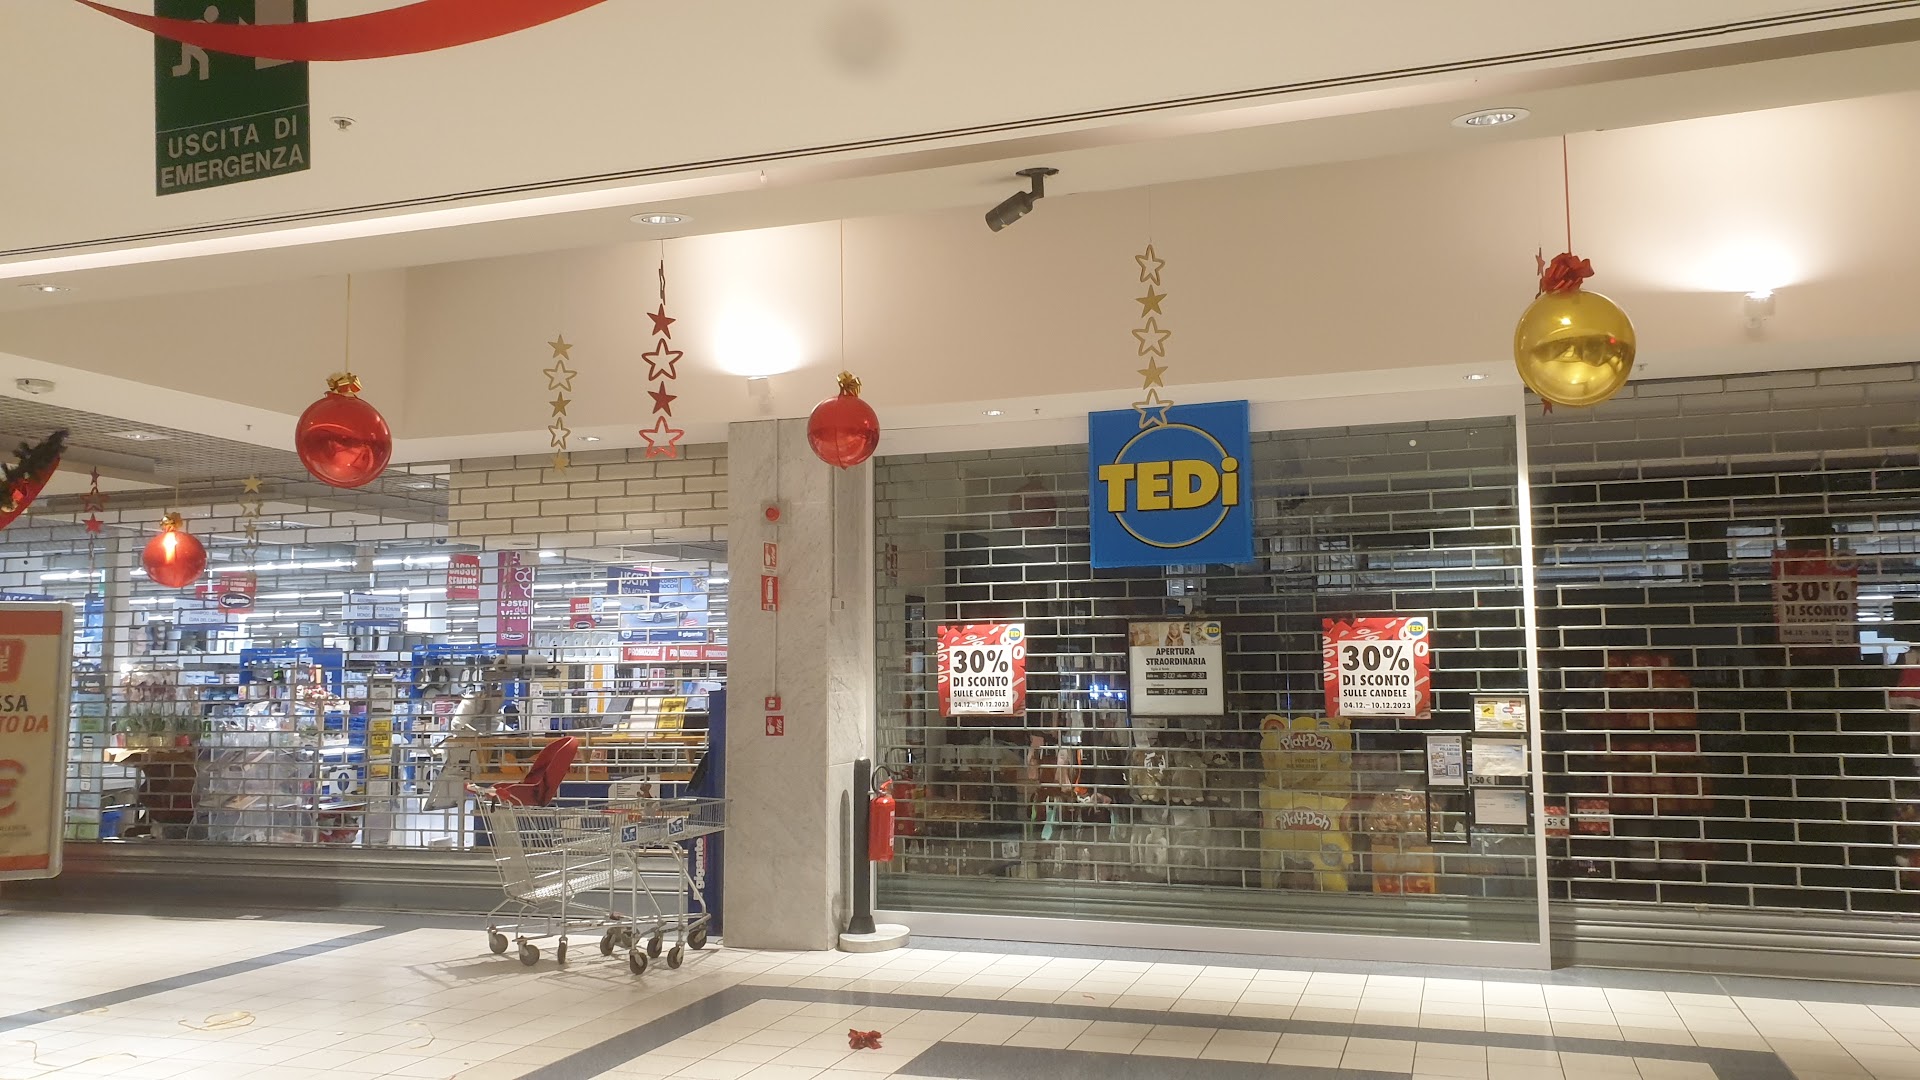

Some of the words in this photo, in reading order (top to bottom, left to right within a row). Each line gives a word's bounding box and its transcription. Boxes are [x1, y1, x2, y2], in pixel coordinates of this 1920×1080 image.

[168, 123, 260, 159] USCITA
[274, 114, 297, 140] DI
[160, 143, 304, 189] EMERGENZA
[1098, 457, 1239, 512] TEDi
[1799, 605, 1848, 616] SCONTO
[1156, 647, 1195, 656] APERTURA
[1342, 645, 1410, 671] 30%
[953, 649, 1009, 673] 30%
[1146, 657, 1206, 666] STRAORDINARIA
[953, 676, 964, 687] DI
[968, 676, 1009, 687] SCONTO
[1343, 675, 1355, 686] DI
[1360, 674, 1410, 686] SCONTO
[953, 690, 973, 698] SULLE
[1343, 689, 1367, 697] SULLE
[1370, 689, 1407, 697] CANDELE
[0, 695, 28, 711] SA
[23, 715, 48, 733] DA
[1281, 733, 1331, 750] Play-Doh
[1279, 810, 1330, 831] Play-Doh
[1560, 818, 1566, 827] €
[693, 837, 705, 889] gigante
